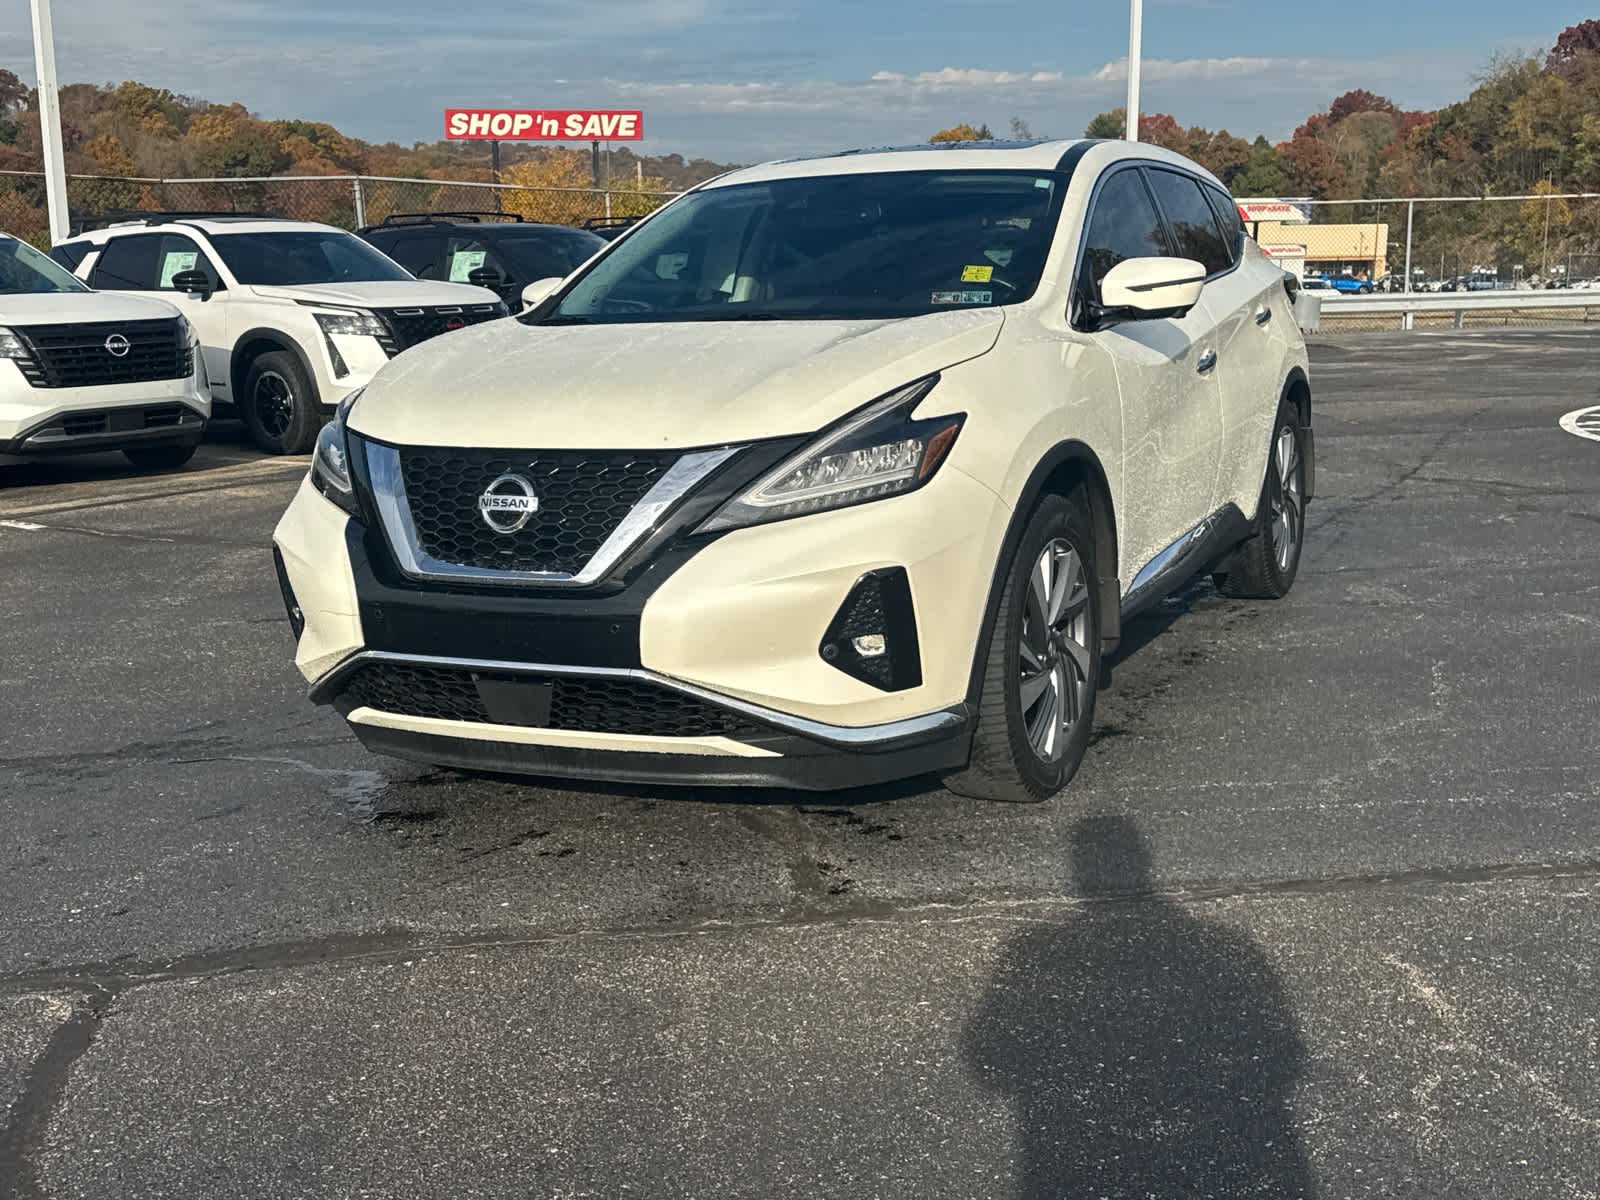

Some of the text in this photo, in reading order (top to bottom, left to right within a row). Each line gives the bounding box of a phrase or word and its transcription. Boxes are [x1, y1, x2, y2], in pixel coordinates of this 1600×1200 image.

[449, 112, 533, 136] SHOP
[564, 114, 638, 137] SAVE
[481, 498, 529, 508] NISSAN
